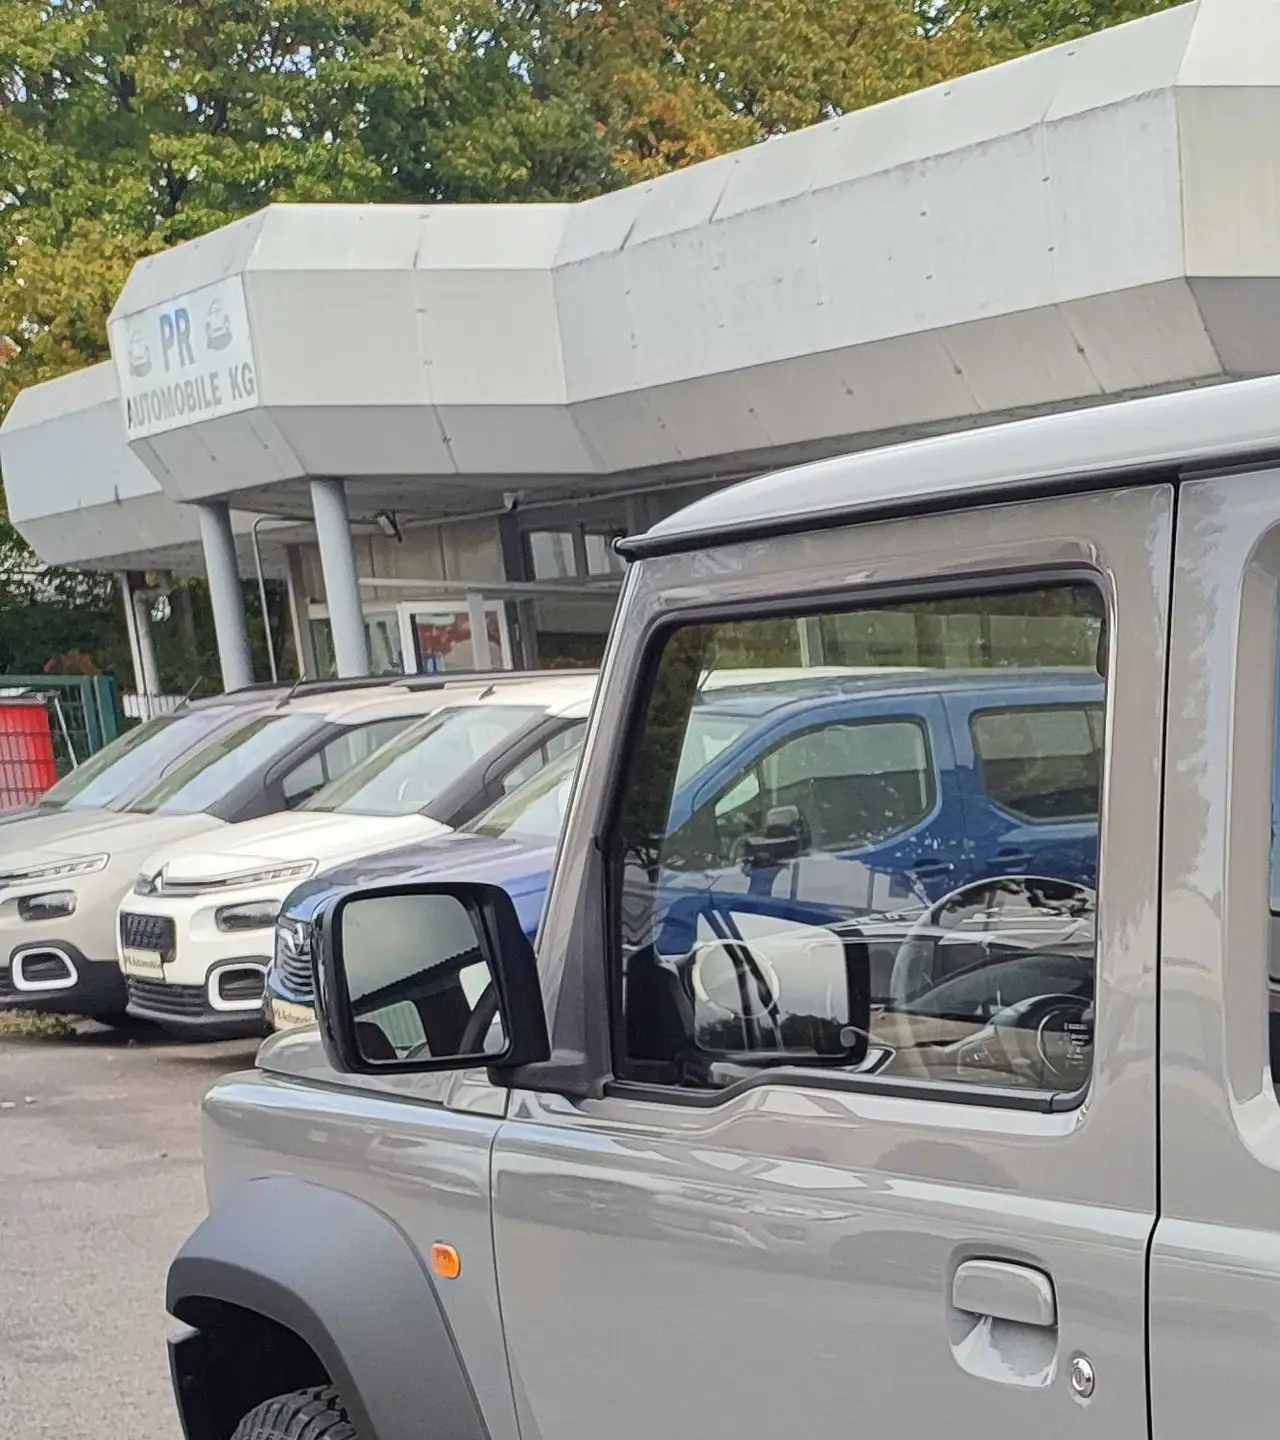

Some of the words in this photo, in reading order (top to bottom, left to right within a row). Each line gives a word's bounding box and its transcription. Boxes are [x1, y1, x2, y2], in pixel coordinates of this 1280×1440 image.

[159, 307, 195, 372] PR
[127, 372, 222, 429] AUTOMOBILE
[229, 362, 255, 401] KG
